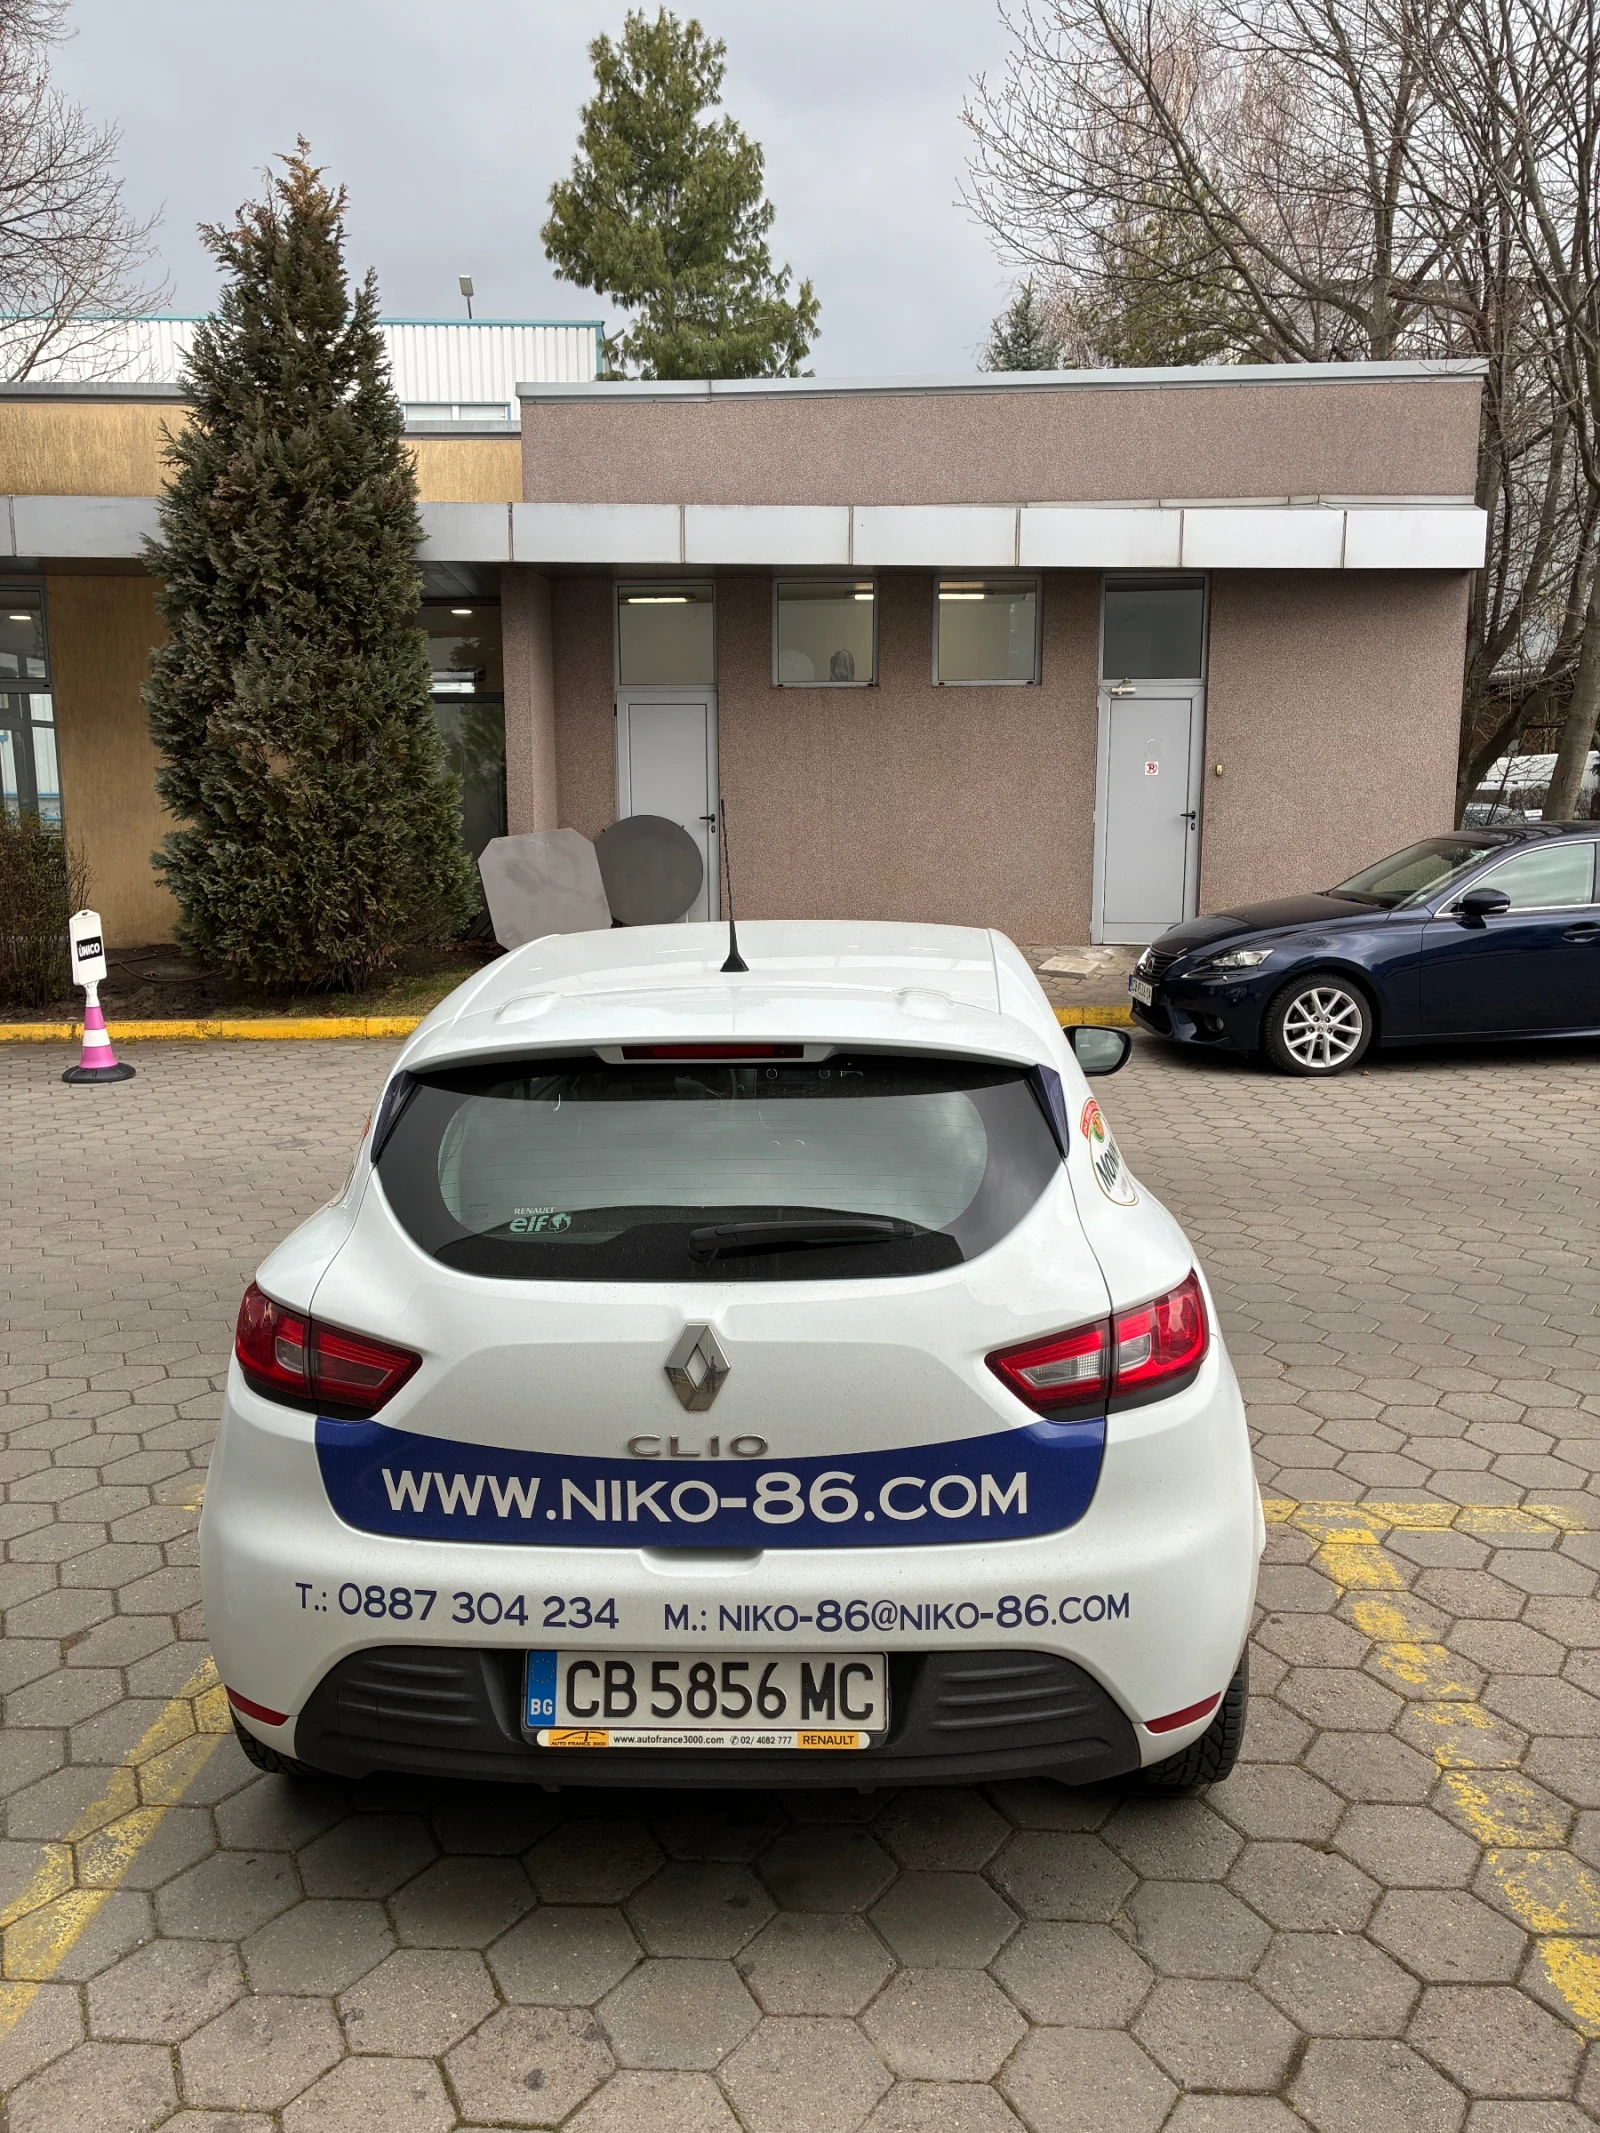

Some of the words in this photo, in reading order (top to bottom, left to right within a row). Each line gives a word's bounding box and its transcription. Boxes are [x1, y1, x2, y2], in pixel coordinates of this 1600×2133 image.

[514, 1206, 556, 1215] RENAULT
[509, 1215, 550, 1232] elf
[627, 1433, 768, 1457] CLIO
[381, 1469, 1028, 1524] WWW.NIKO-86.COM
[295, 1582, 327, 1612] T.:
[338, 1582, 437, 1621] 0887
[451, 1591, 529, 1627] 304
[543, 1595, 620, 1630] 234
[664, 1603, 707, 1632] M.:
[719, 1593, 1130, 1633] NIKO-86@NIKO-86.COM
[566, 1660, 637, 1718] CB
[651, 1661, 787, 1720] 5856
[800, 1661, 874, 1721] MC
[530, 1699, 553, 1716] BG
[613, 1735, 725, 1745] www.autofrance3000.com
[756, 1736, 775, 1745] 4082
[778, 1737, 792, 1745] 777
[802, 1735, 854, 1745] RENAULT
